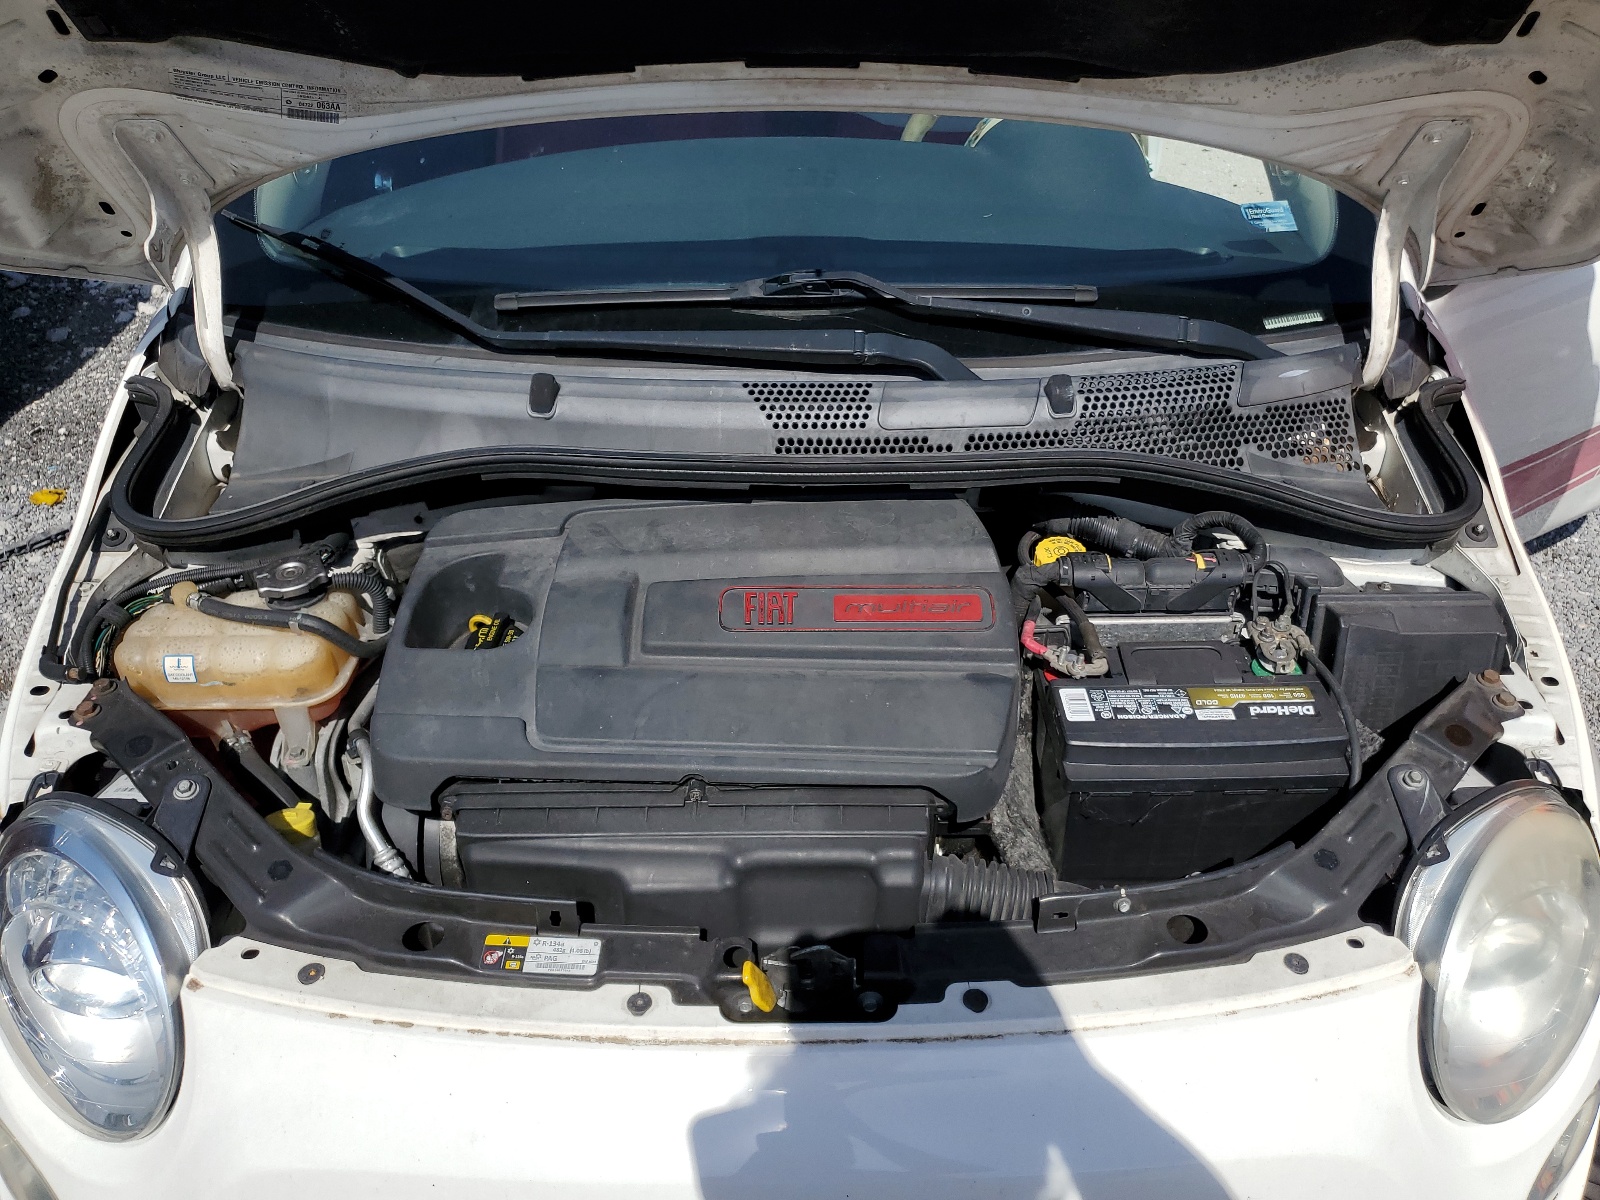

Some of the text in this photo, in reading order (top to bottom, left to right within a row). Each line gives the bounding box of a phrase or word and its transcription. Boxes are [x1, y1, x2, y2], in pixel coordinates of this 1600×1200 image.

[197, 71, 213, 79] Group
[232, 76, 254, 84] VEHICLE
[255, 79, 281, 87] EMISSION
[281, 82, 305, 90] CONTROL
[306, 85, 341, 93] INFORMATION
[743, 591, 799, 626] FIAT
[844, 598, 971, 617] multiair
[1248, 705, 1315, 717] DieHard
